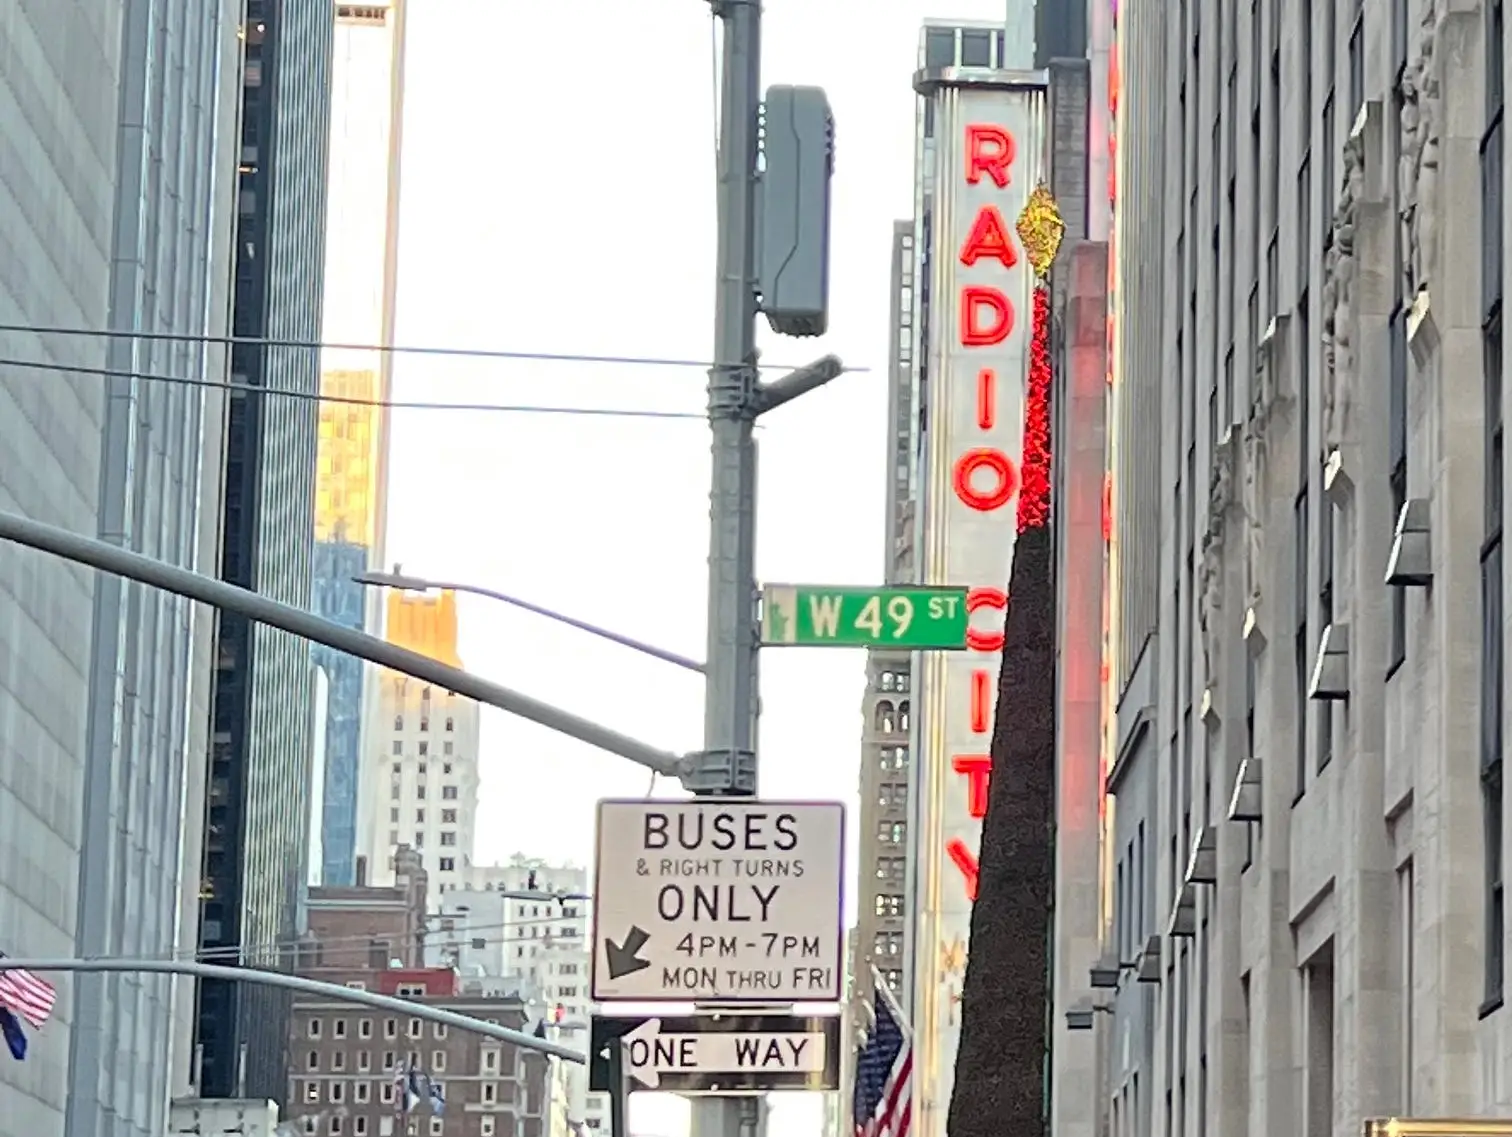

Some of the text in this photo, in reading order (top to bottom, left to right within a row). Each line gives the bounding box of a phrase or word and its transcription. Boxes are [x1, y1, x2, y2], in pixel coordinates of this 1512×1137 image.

[952, 123, 1019, 511] RADIO
[809, 594, 959, 639] W 49 ST
[644, 812, 798, 851] BUSES
[636, 858, 805, 877] & RIGHT TURNS
[657, 884, 780, 922] ONLY
[662, 967, 831, 990] MON THRU FRI
[630, 1037, 809, 1067] ONE WAY
